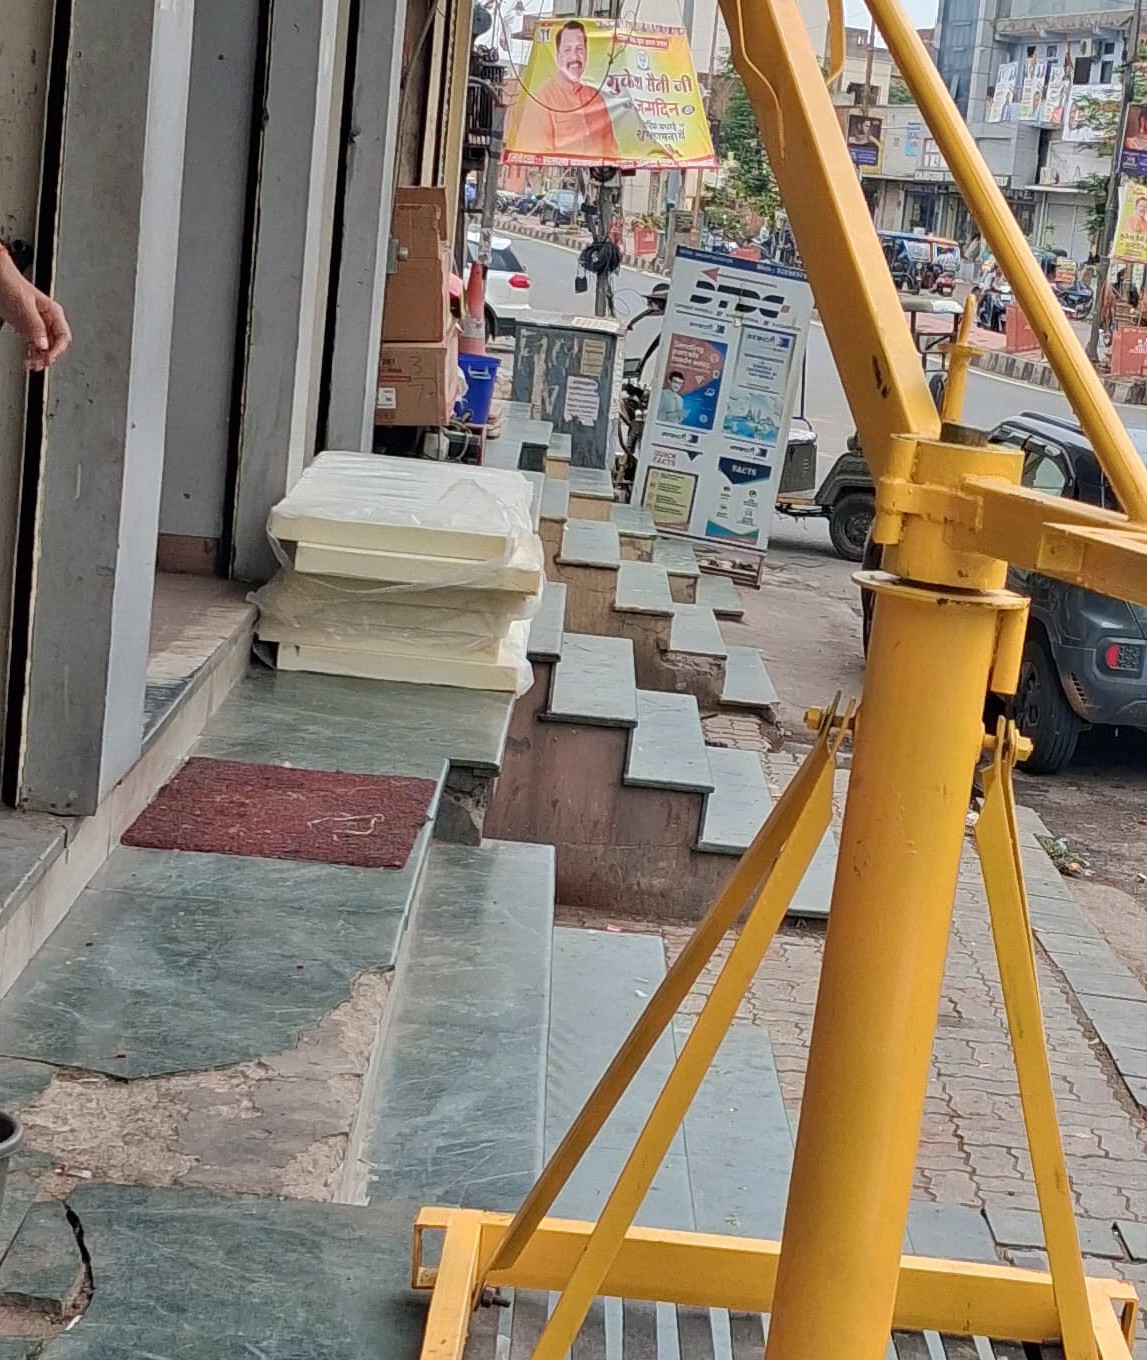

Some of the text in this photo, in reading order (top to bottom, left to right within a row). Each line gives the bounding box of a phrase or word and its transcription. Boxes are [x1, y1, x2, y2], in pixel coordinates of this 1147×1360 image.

[606, 68, 692, 95] मुकेश सैनी जी
[690, 280, 785, 319] DTDC
